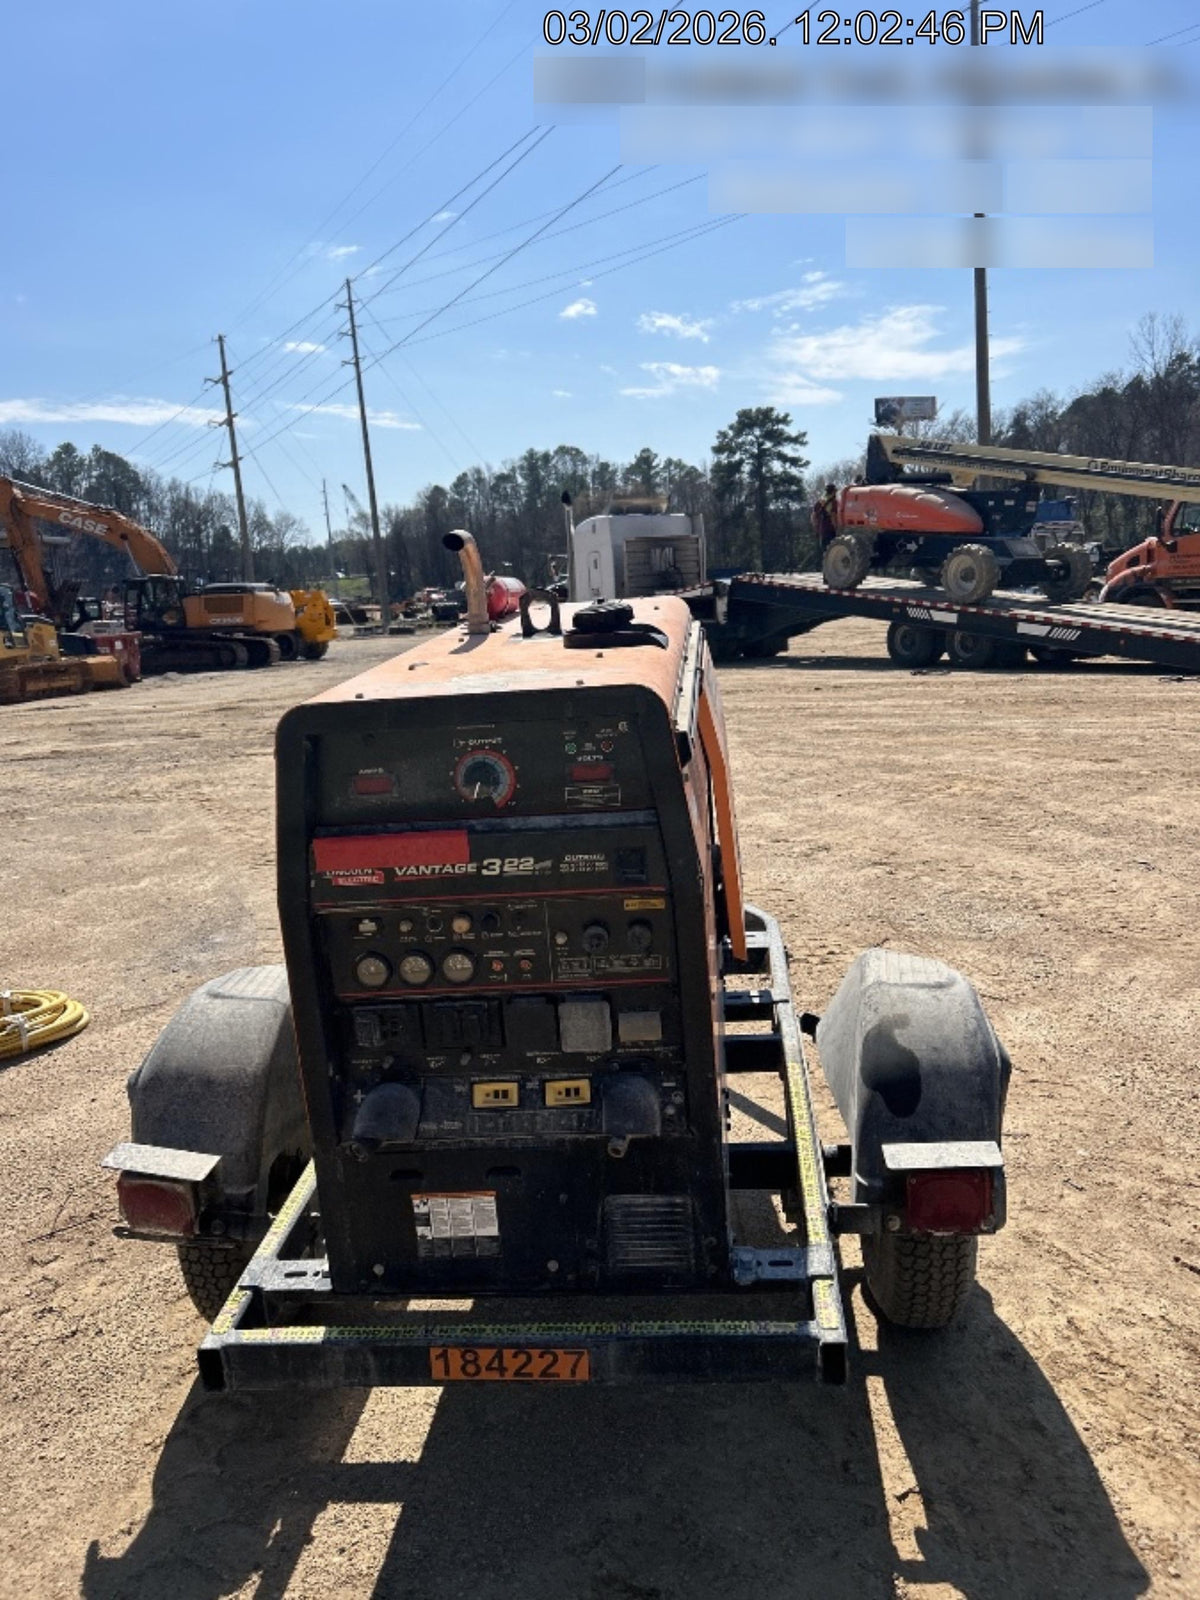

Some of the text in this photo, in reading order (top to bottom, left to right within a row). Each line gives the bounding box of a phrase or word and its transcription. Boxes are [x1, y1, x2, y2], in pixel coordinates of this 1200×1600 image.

[59, 511, 109, 536] CASE
[395, 856, 534, 876] VANTAGE 322
[434, 1349, 586, 1378] 184227
